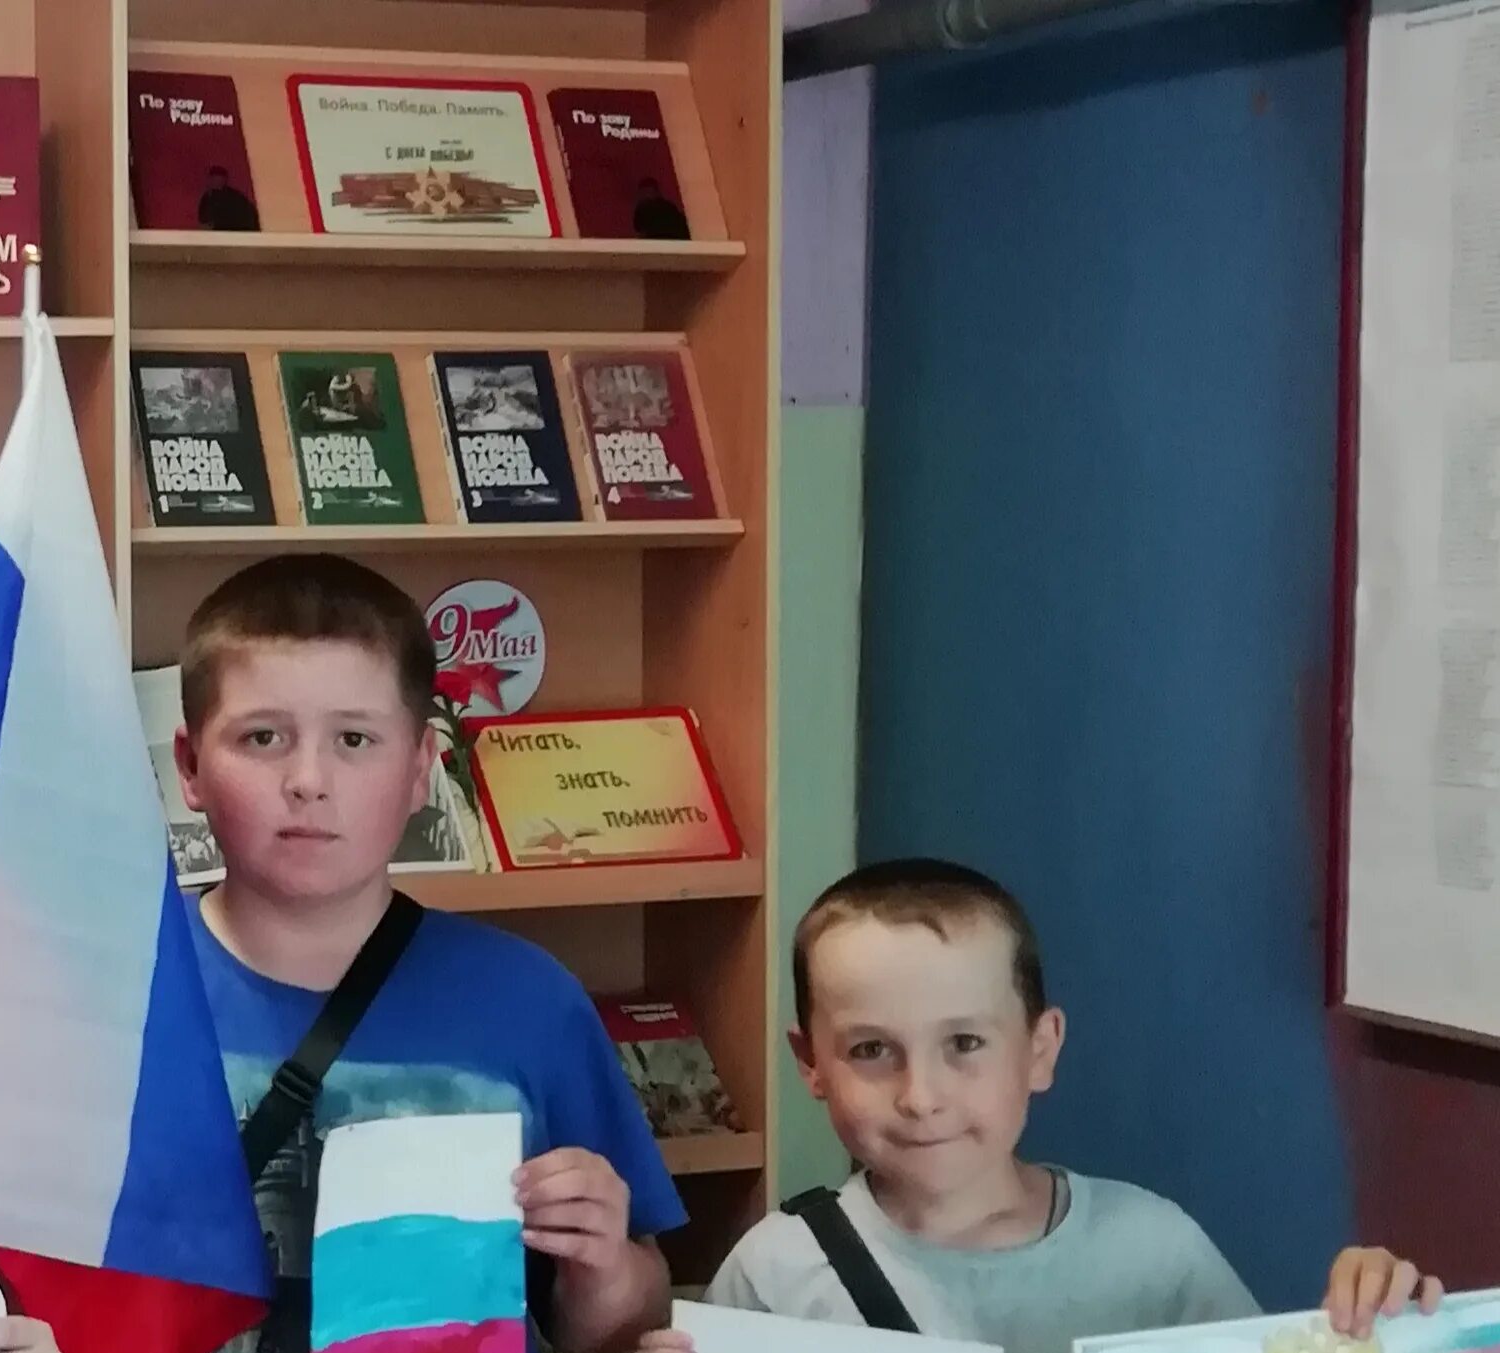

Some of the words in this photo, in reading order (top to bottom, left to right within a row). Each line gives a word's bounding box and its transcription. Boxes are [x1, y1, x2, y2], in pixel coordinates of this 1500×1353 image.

[150, 437, 225, 458] ВОЙНА
[301, 433, 375, 454] ВОЙНА
[152, 456, 228, 475] НАРОД
[304, 453, 377, 471] НАРОД
[156, 473, 243, 491] ПОБЕДА
[308, 469, 393, 488] ПОБЕДА
[311, 491, 323, 510] 2
[428, 604, 469, 663] 9
[467, 631, 538, 662] Мая
[603, 806, 708, 829] помнить
